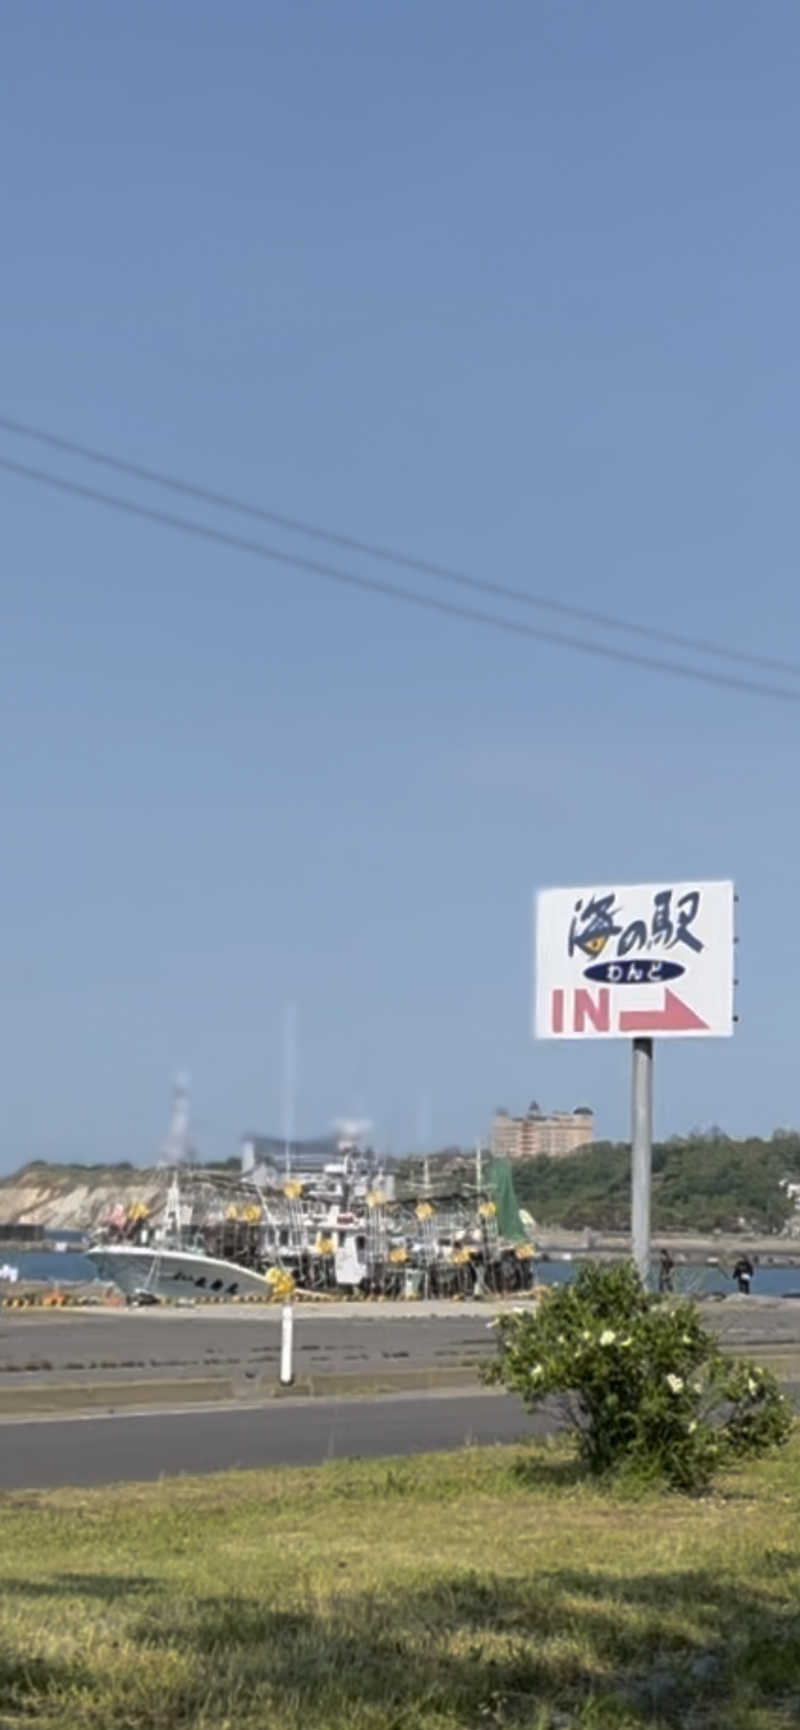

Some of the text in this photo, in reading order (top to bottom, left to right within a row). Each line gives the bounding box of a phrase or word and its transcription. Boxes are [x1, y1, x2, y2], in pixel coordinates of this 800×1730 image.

[568, 889, 705, 961] 海の駅
[605, 961, 664, 981] わんど
[552, 987, 610, 1034] IN
